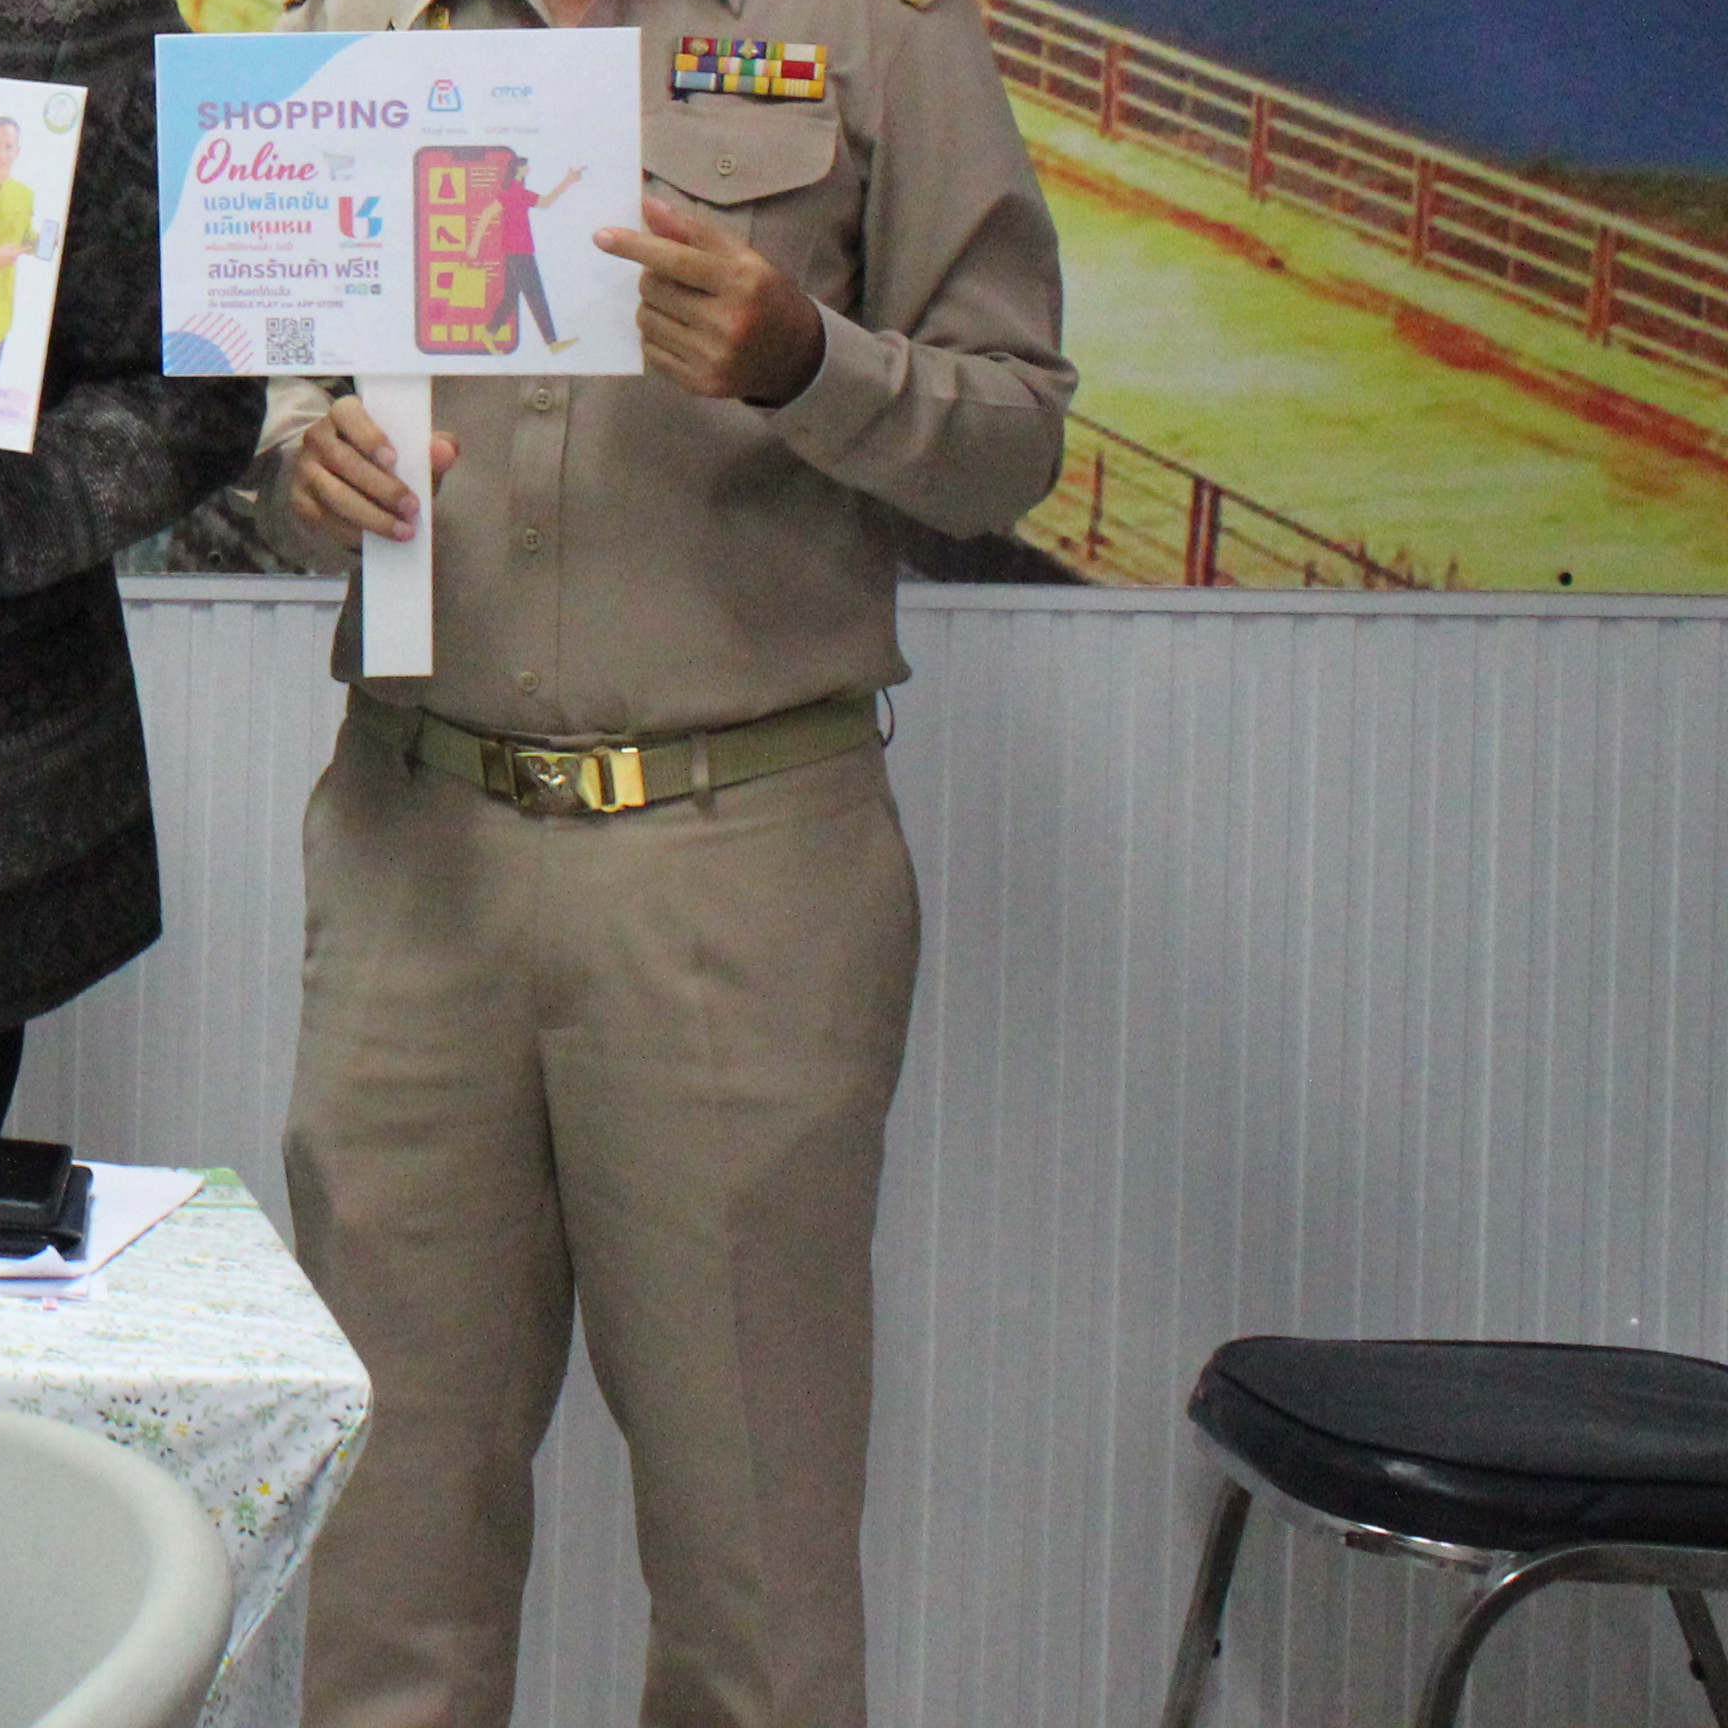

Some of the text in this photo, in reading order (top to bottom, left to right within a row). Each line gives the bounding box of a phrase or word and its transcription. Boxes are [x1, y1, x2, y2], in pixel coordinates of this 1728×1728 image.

[197, 100, 410, 130] SHOPPING
[196, 138, 319, 185] Online
[204, 191, 329, 212] แอปพลิเคชัน
[208, 257, 380, 280] สมัครร้านค้า ฟรี!!
